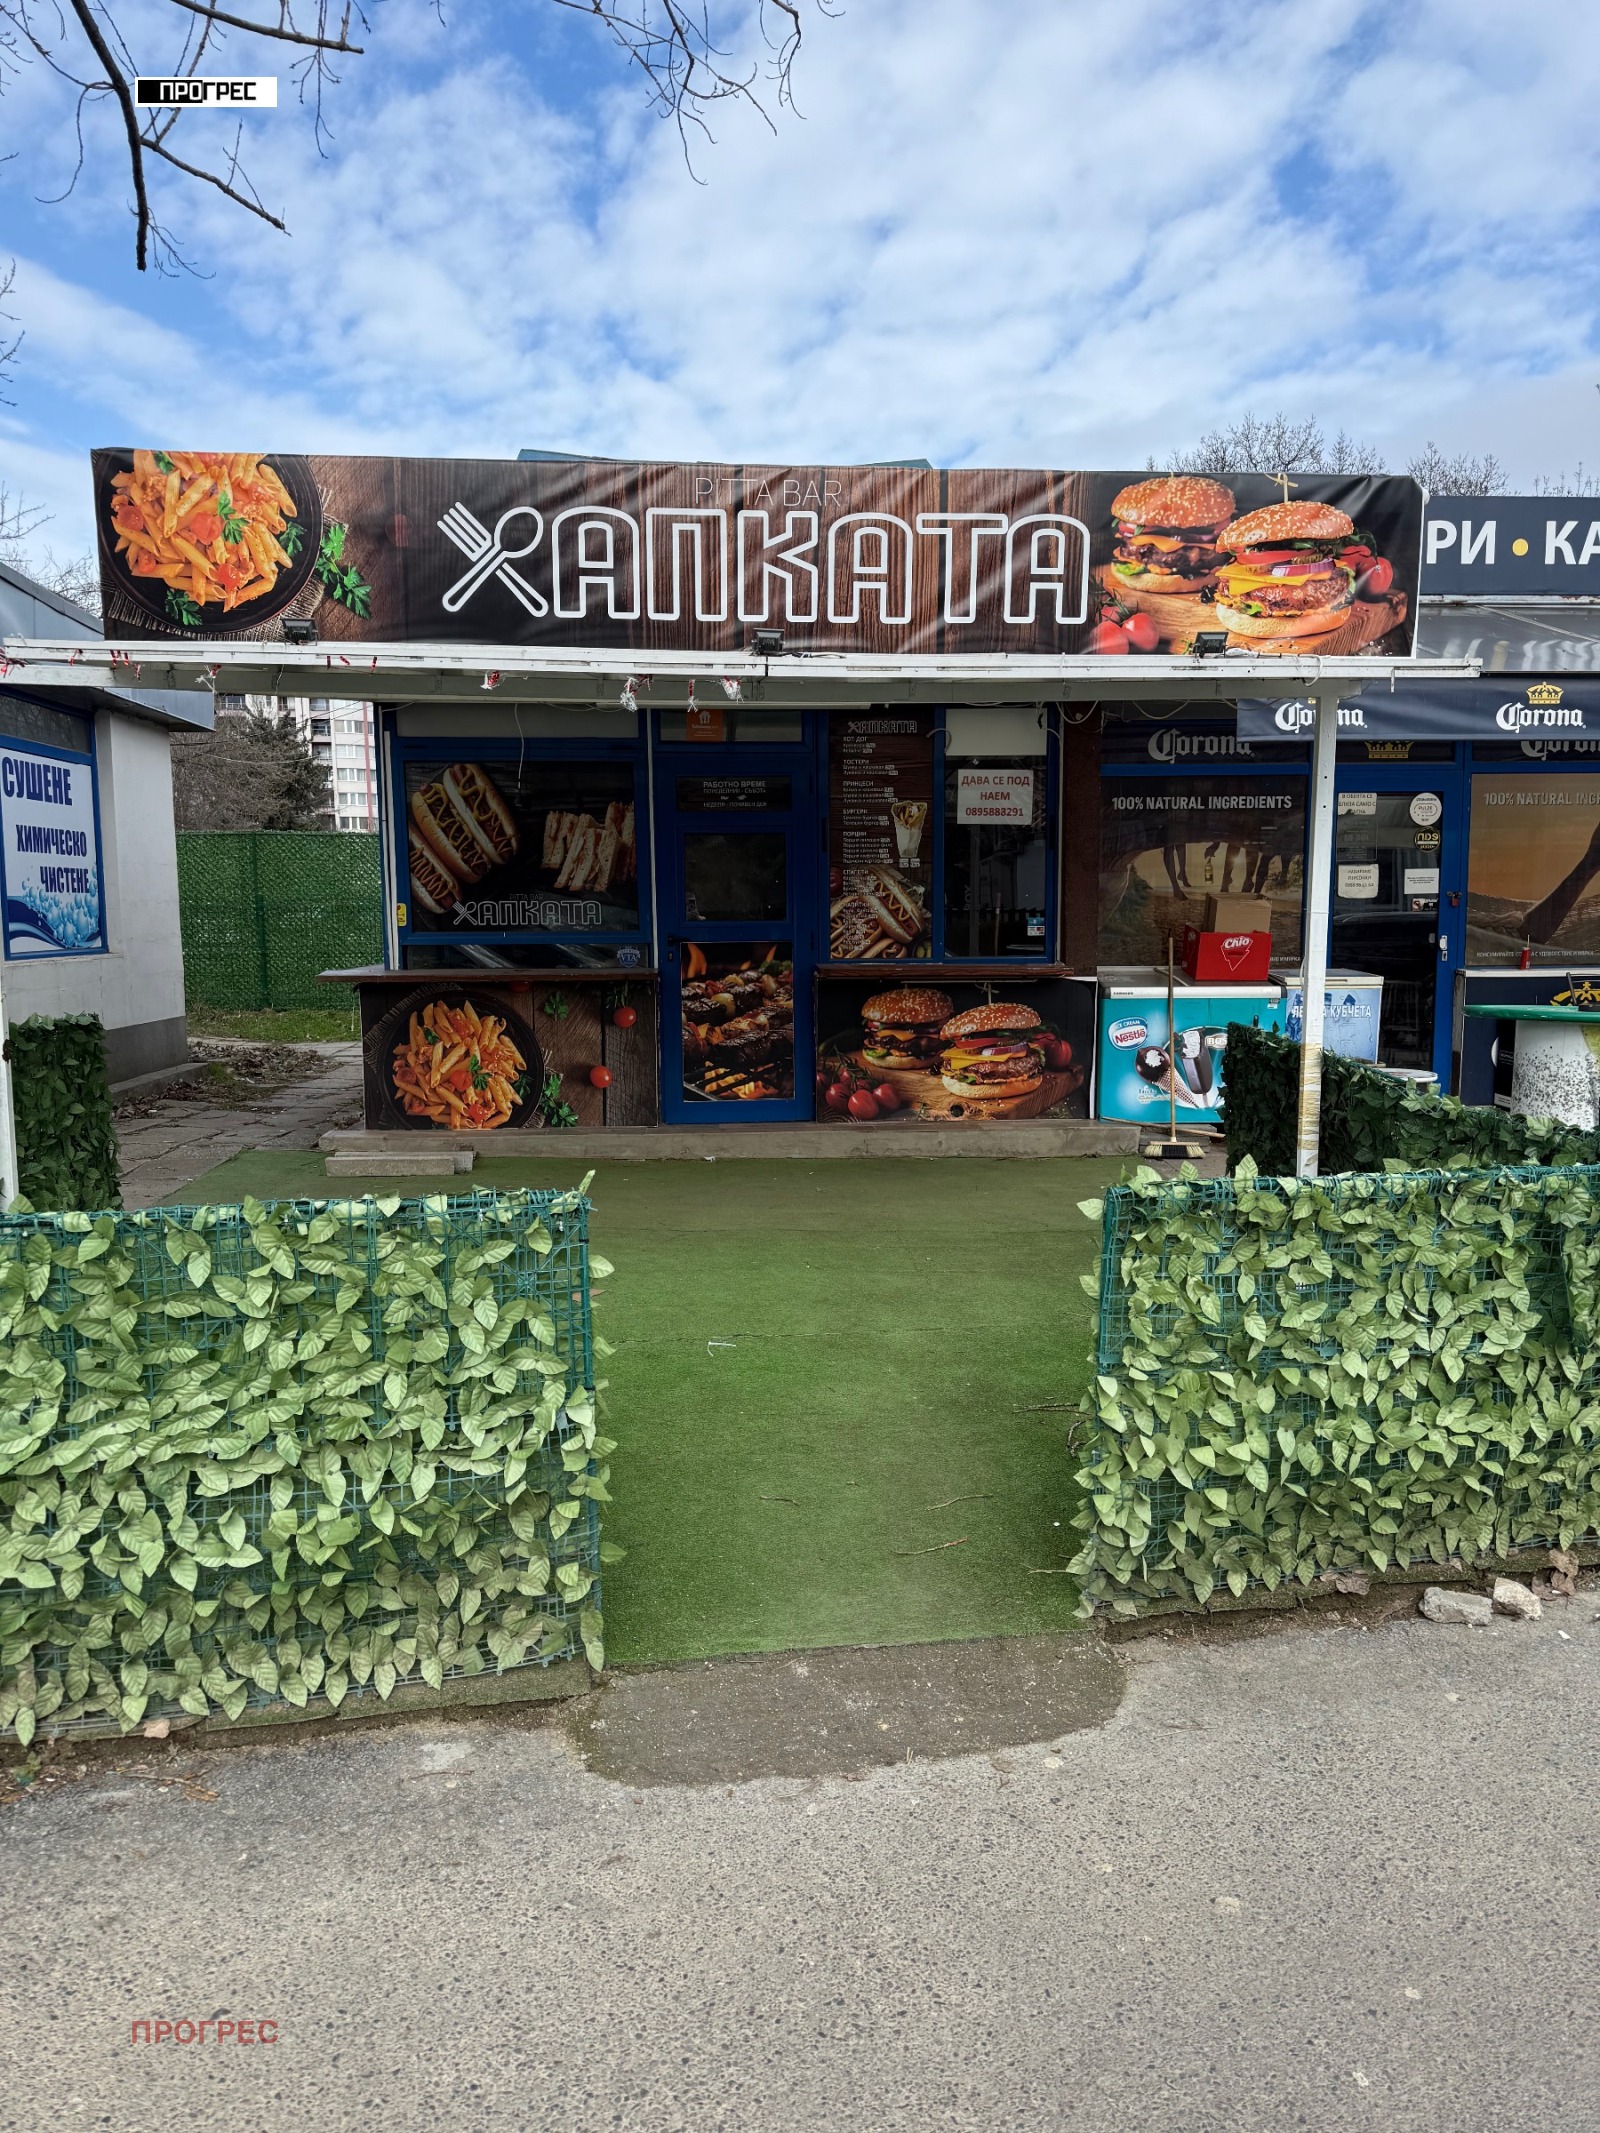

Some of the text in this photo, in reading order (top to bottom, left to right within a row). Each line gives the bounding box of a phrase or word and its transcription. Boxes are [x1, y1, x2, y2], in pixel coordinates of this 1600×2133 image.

[695, 477, 842, 507] PITTA BAR
[1426, 519, 1497, 565] РИ
[1496, 702, 1584, 733] Corona
[2, 756, 73, 806] СУШЕНЕ
[740, 780, 766, 788] ВРЕМЕ
[961, 775, 1030, 787] ДАВА СЕ ПОД
[980, 791, 1011, 801] НАЕМ
[1111, 795, 1292, 810] 100% NATURAL INGREDIENTS
[1483, 792, 1515, 805] 100%
[1516, 792, 1573, 805] NATURAL
[15, 824, 88, 857] ХИМИЧЕСКО
[39, 866, 90, 894] ЧИСТЕНЕ
[1224, 935, 1250, 949] Chio
[621, 953, 636, 962] VTA
[1330, 1005, 1372, 1018] КУБЧЕТА
[1123, 1019, 1140, 1027] CREAM
